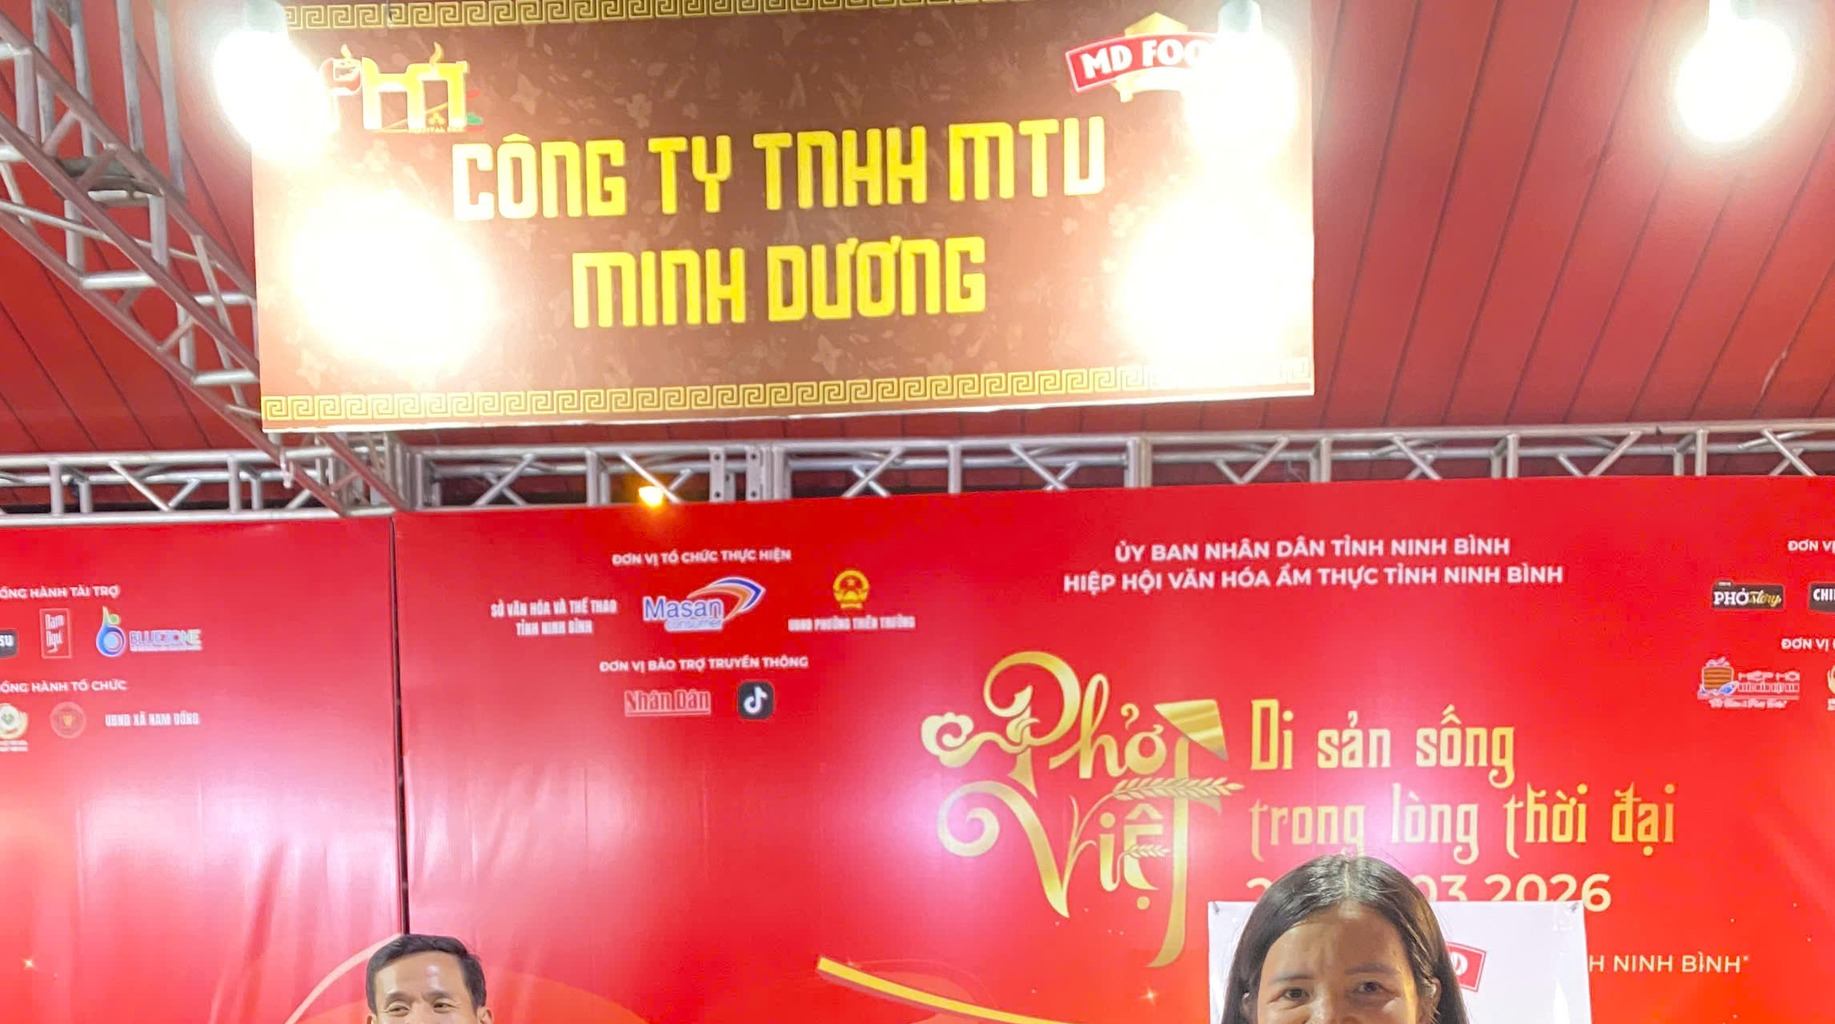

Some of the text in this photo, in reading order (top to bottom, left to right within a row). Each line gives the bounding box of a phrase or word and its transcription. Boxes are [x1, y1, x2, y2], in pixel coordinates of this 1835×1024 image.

[1080, 38, 1202, 79] MD FOO
[452, 133, 627, 220] CÔNG
[648, 135, 732, 215] TY
[752, 126, 927, 210] TNHH
[572, 236, 985, 328] MINH DƯƠNG
[611, 553, 642, 566] ĐƠN
[644, 553, 659, 567] VỊ
[681, 549, 718, 564] CHỨC
[721, 548, 757, 563] THỰC
[759, 547, 792, 563] HIỆN
[1114, 534, 1511, 562] ỦY BAN NHÂN DÂN TỈNH NINH BÌNH
[1787, 539, 1819, 553] ĐƠN
[1063, 562, 1563, 596] HIỆP HỘI VĂN HÓA ẨM THỰC TỈNH NINH BÌNH
[0, 586, 27, 599] ỒNG
[30, 585, 67, 598] HÀNH
[70, 584, 90, 597] TÀI
[591, 599, 618, 614] THAO
[644, 597, 722, 619] Masan
[1781, 637, 1812, 650] ĐƠN
[599, 654, 809, 674] ĐƠN VỊ BẢO TRỢ TRUYỀN THÔNG
[31, 680, 69, 693] HÀNH
[91, 678, 128, 692] CHỨC
[625, 689, 673, 712] Nhân
[921, 650, 1167, 798] Phở
[1250, 698, 1516, 789] Di sản sống
[1249, 781, 1676, 865] trong lòng thời đại
[1613, 954, 1673, 972] NINH
